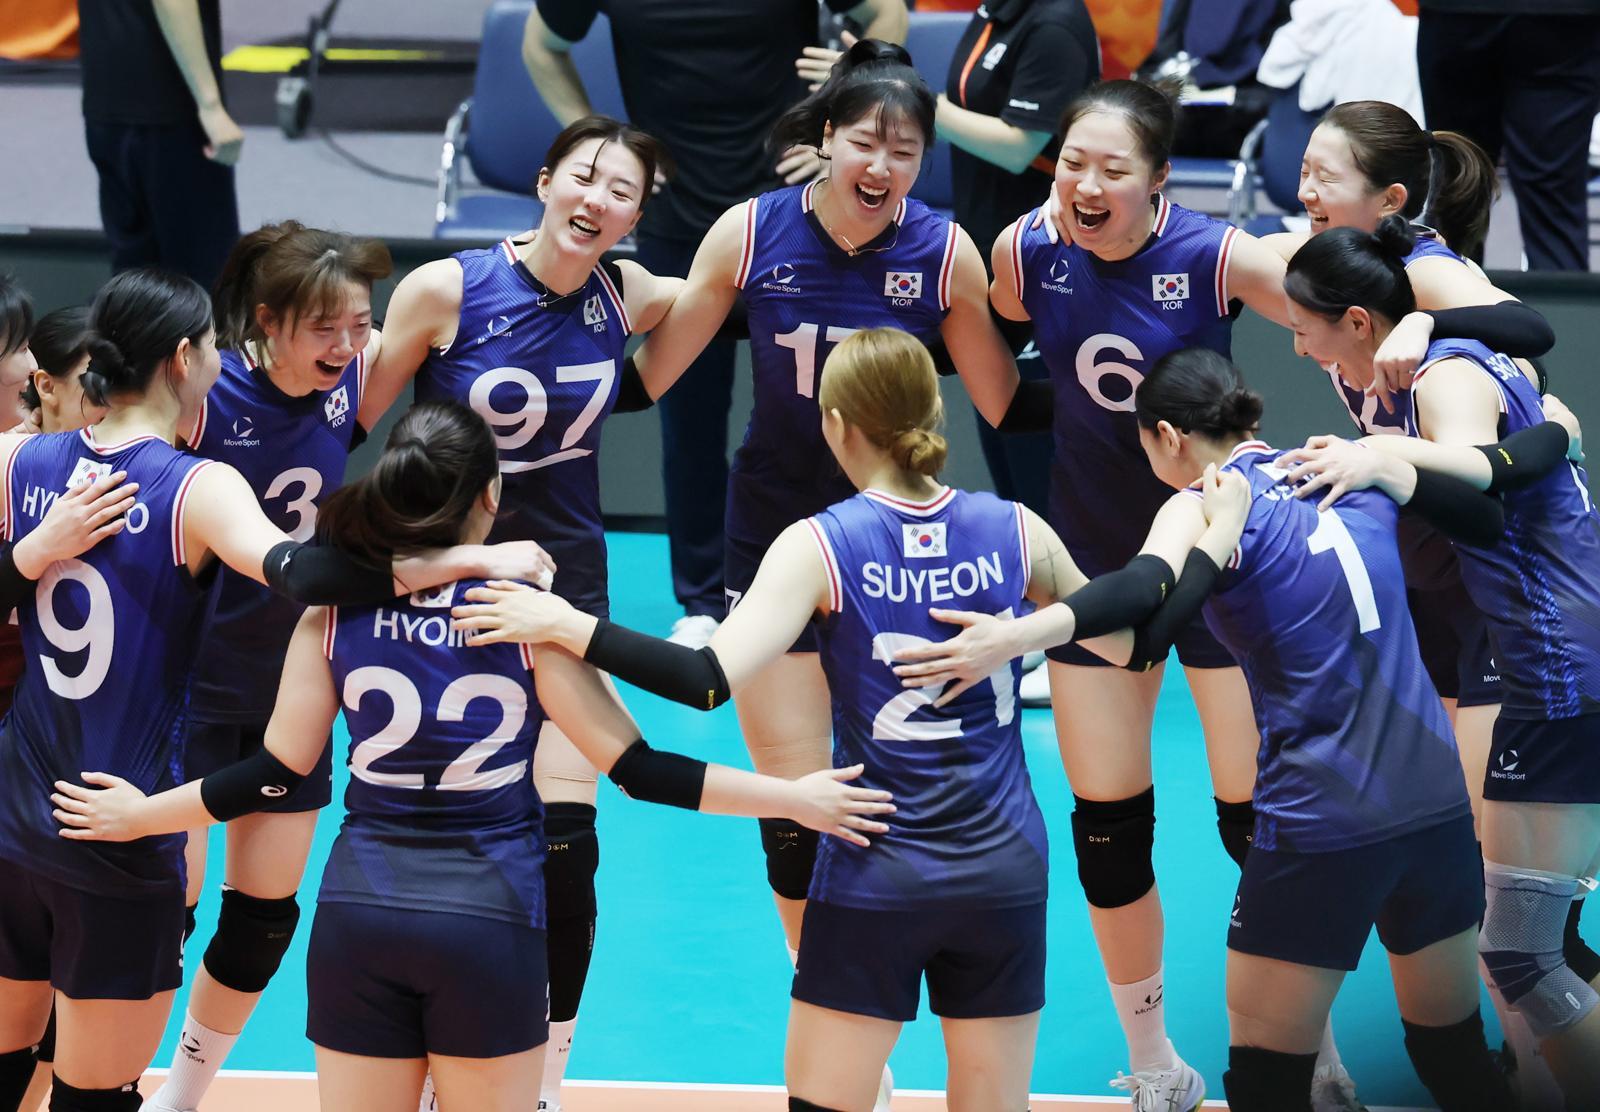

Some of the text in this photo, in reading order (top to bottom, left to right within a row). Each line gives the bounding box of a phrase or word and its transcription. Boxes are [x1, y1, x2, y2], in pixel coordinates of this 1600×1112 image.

[892, 298, 913, 306] KOR
[1162, 301, 1183, 310] KOR
[1075, 333, 1146, 412] 6
[332, 414, 346, 428] KOR
[264, 467, 323, 544] 3
[862, 552, 1004, 604] SUYEON
[1307, 508, 1382, 635] 1
[35, 557, 115, 700] 9
[343, 665, 528, 791] 22
